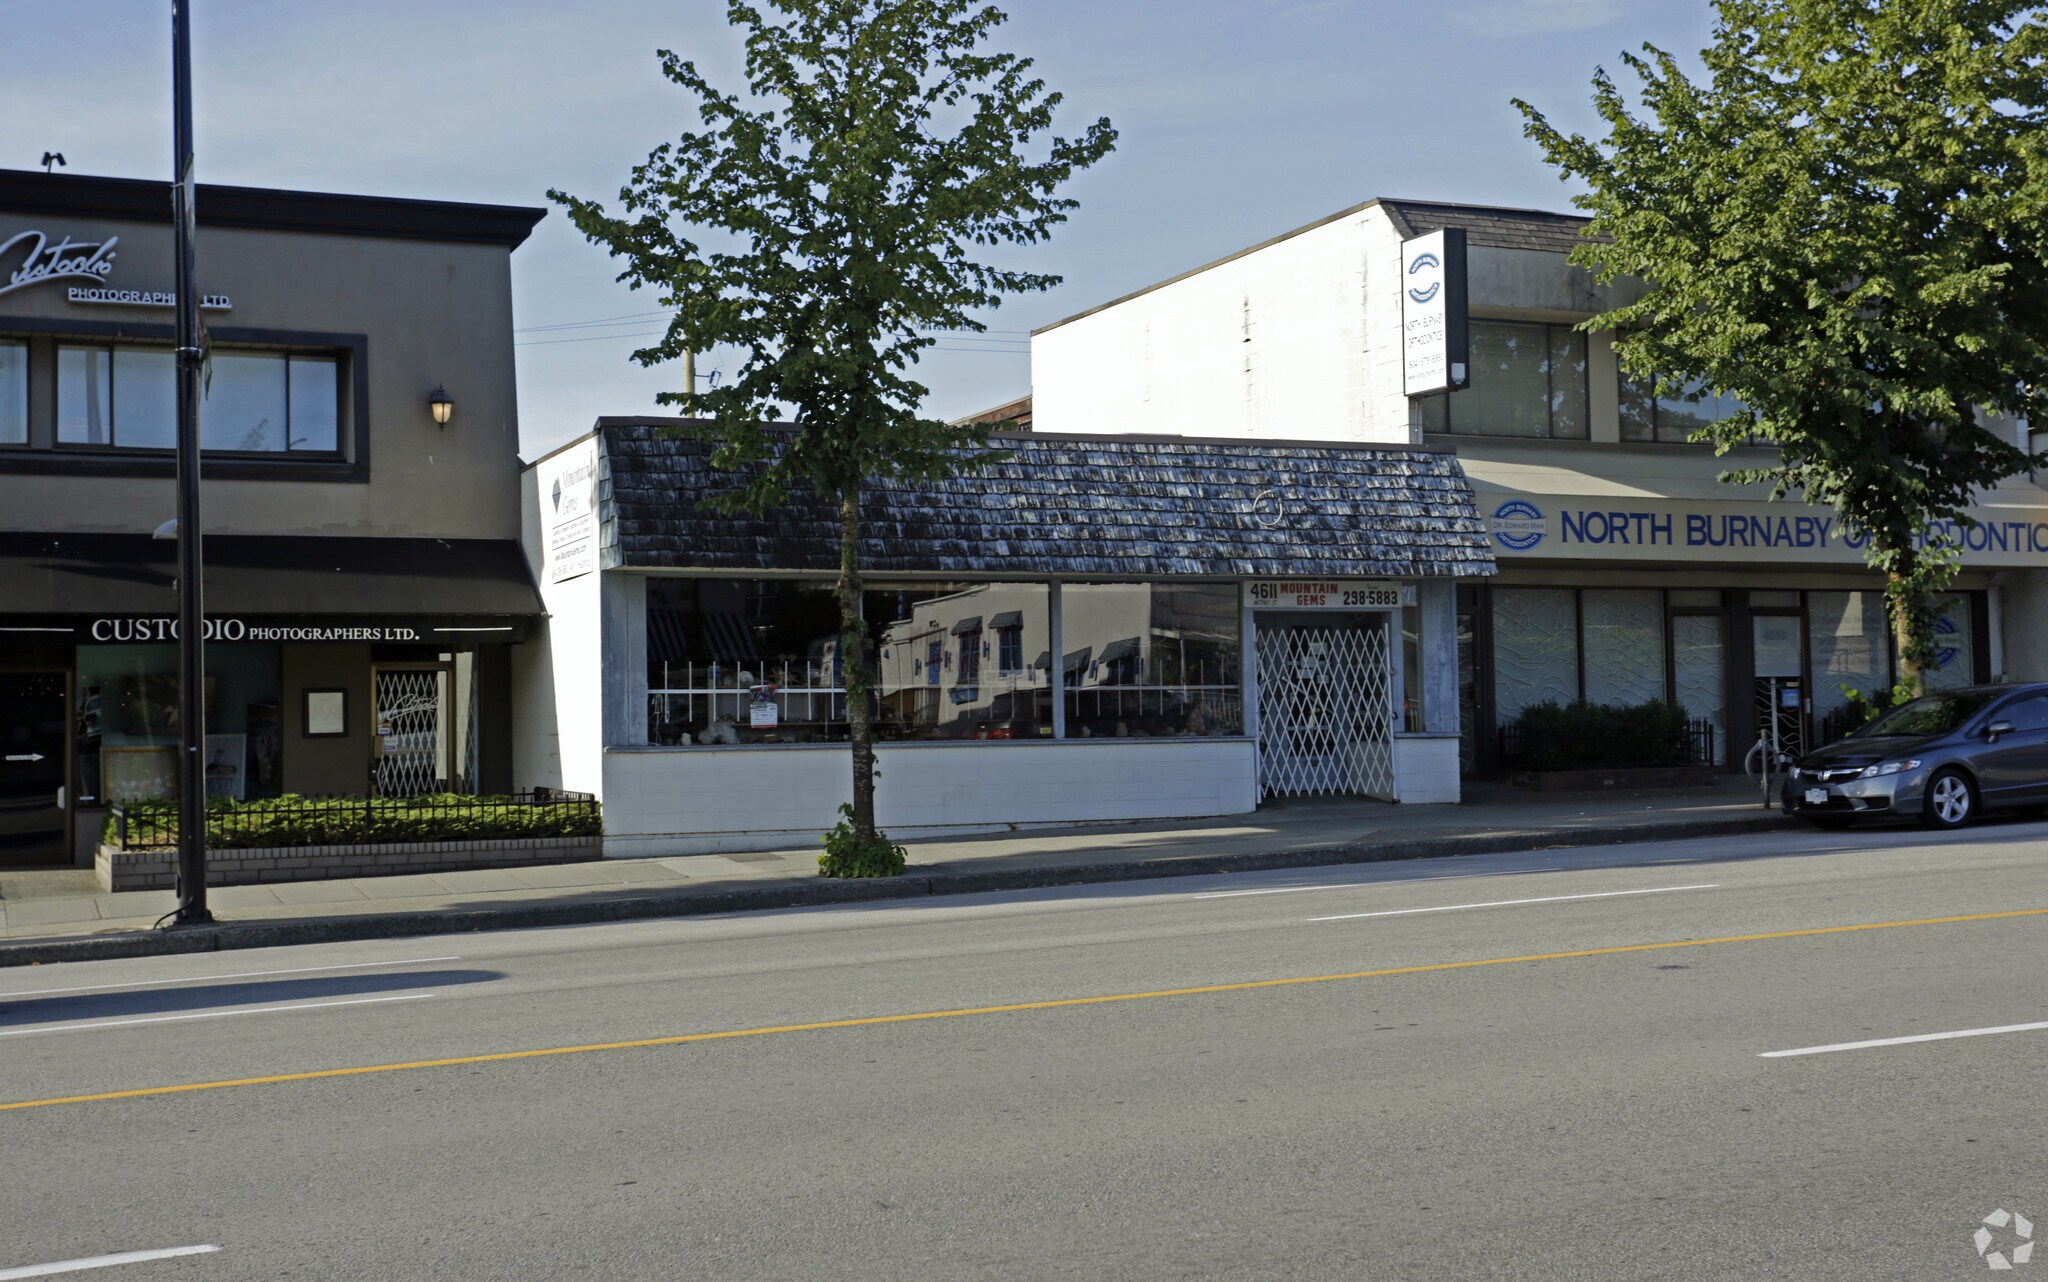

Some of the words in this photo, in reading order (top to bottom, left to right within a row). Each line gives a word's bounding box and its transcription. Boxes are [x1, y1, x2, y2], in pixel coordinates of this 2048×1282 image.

[1561, 511, 1673, 545] NORTH
[1685, 513, 1833, 548] BURNABY
[1250, 583, 1278, 599] 4611
[1280, 582, 1338, 594] MOUNTAIN
[1296, 594, 1326, 606] GEMS
[248, 627, 382, 641] PHOTOGRAPHERS
[384, 628, 421, 641] LTD.
